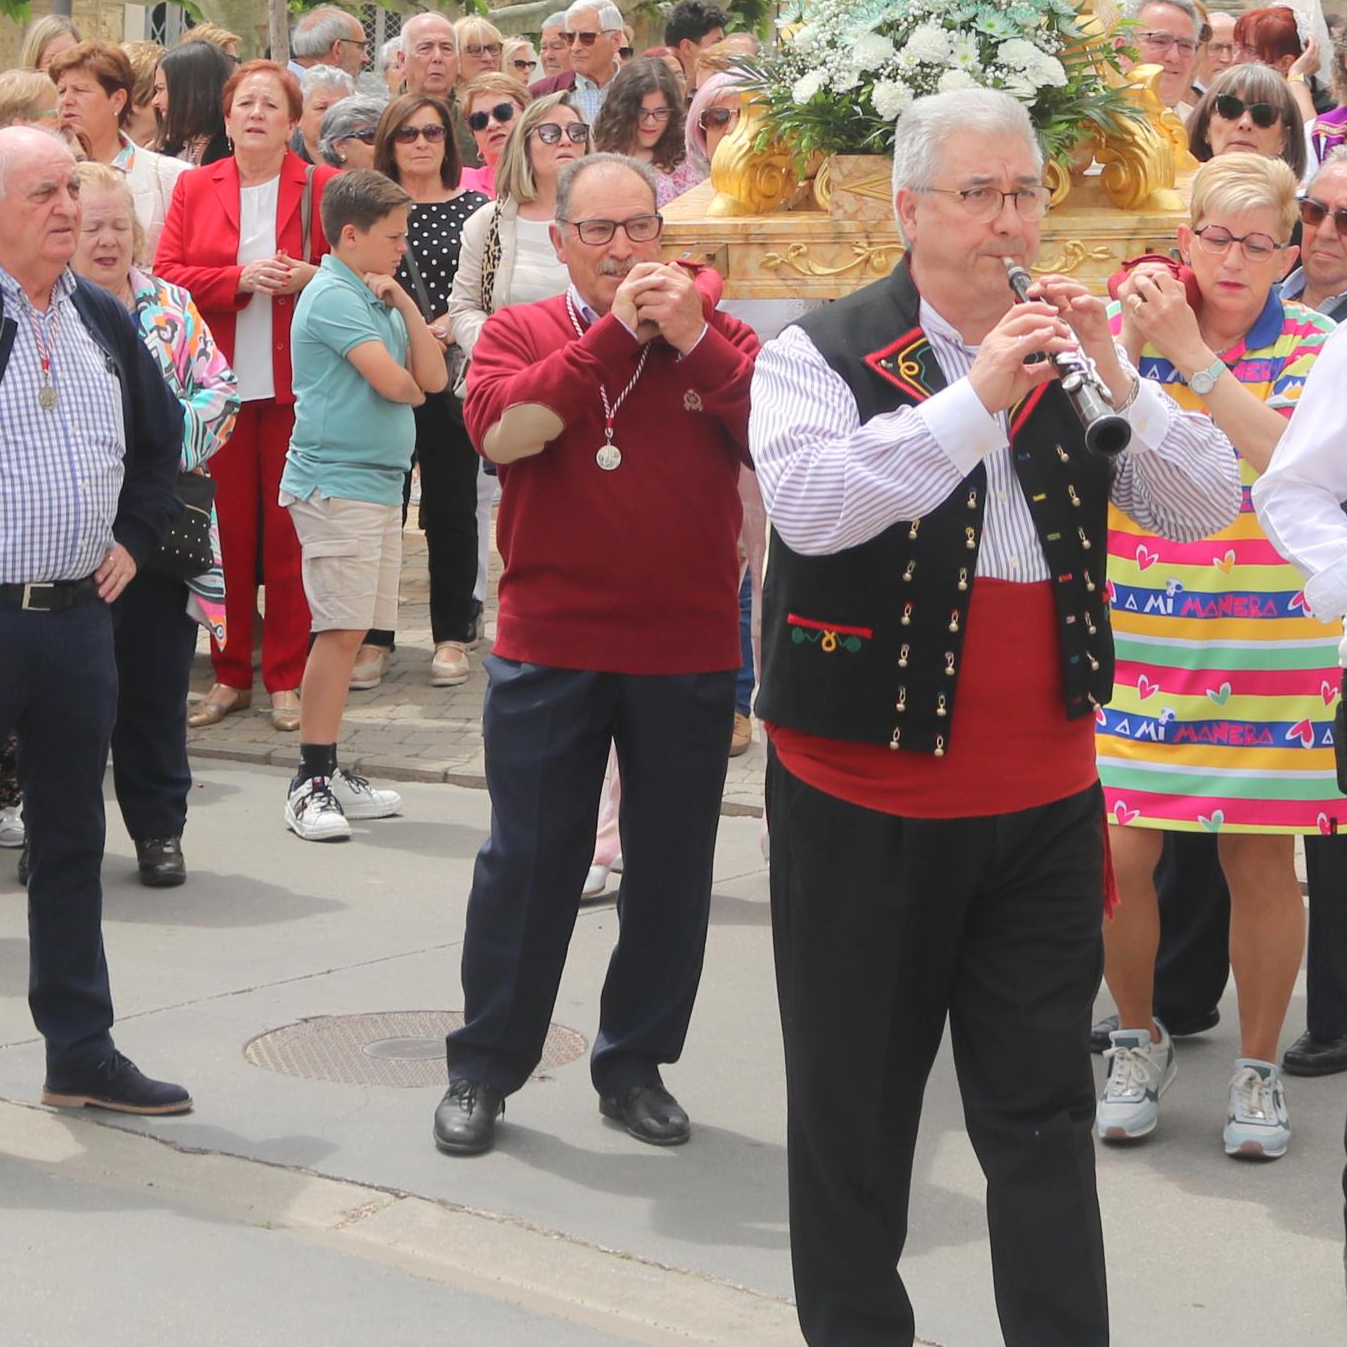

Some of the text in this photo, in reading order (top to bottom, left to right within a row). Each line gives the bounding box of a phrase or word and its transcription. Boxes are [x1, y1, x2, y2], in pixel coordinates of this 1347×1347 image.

[1124, 593, 1138, 611] A
[1179, 595, 1278, 619] MANERA
[1114, 718, 1131, 736] A
[1172, 722, 1274, 745] MANERA
